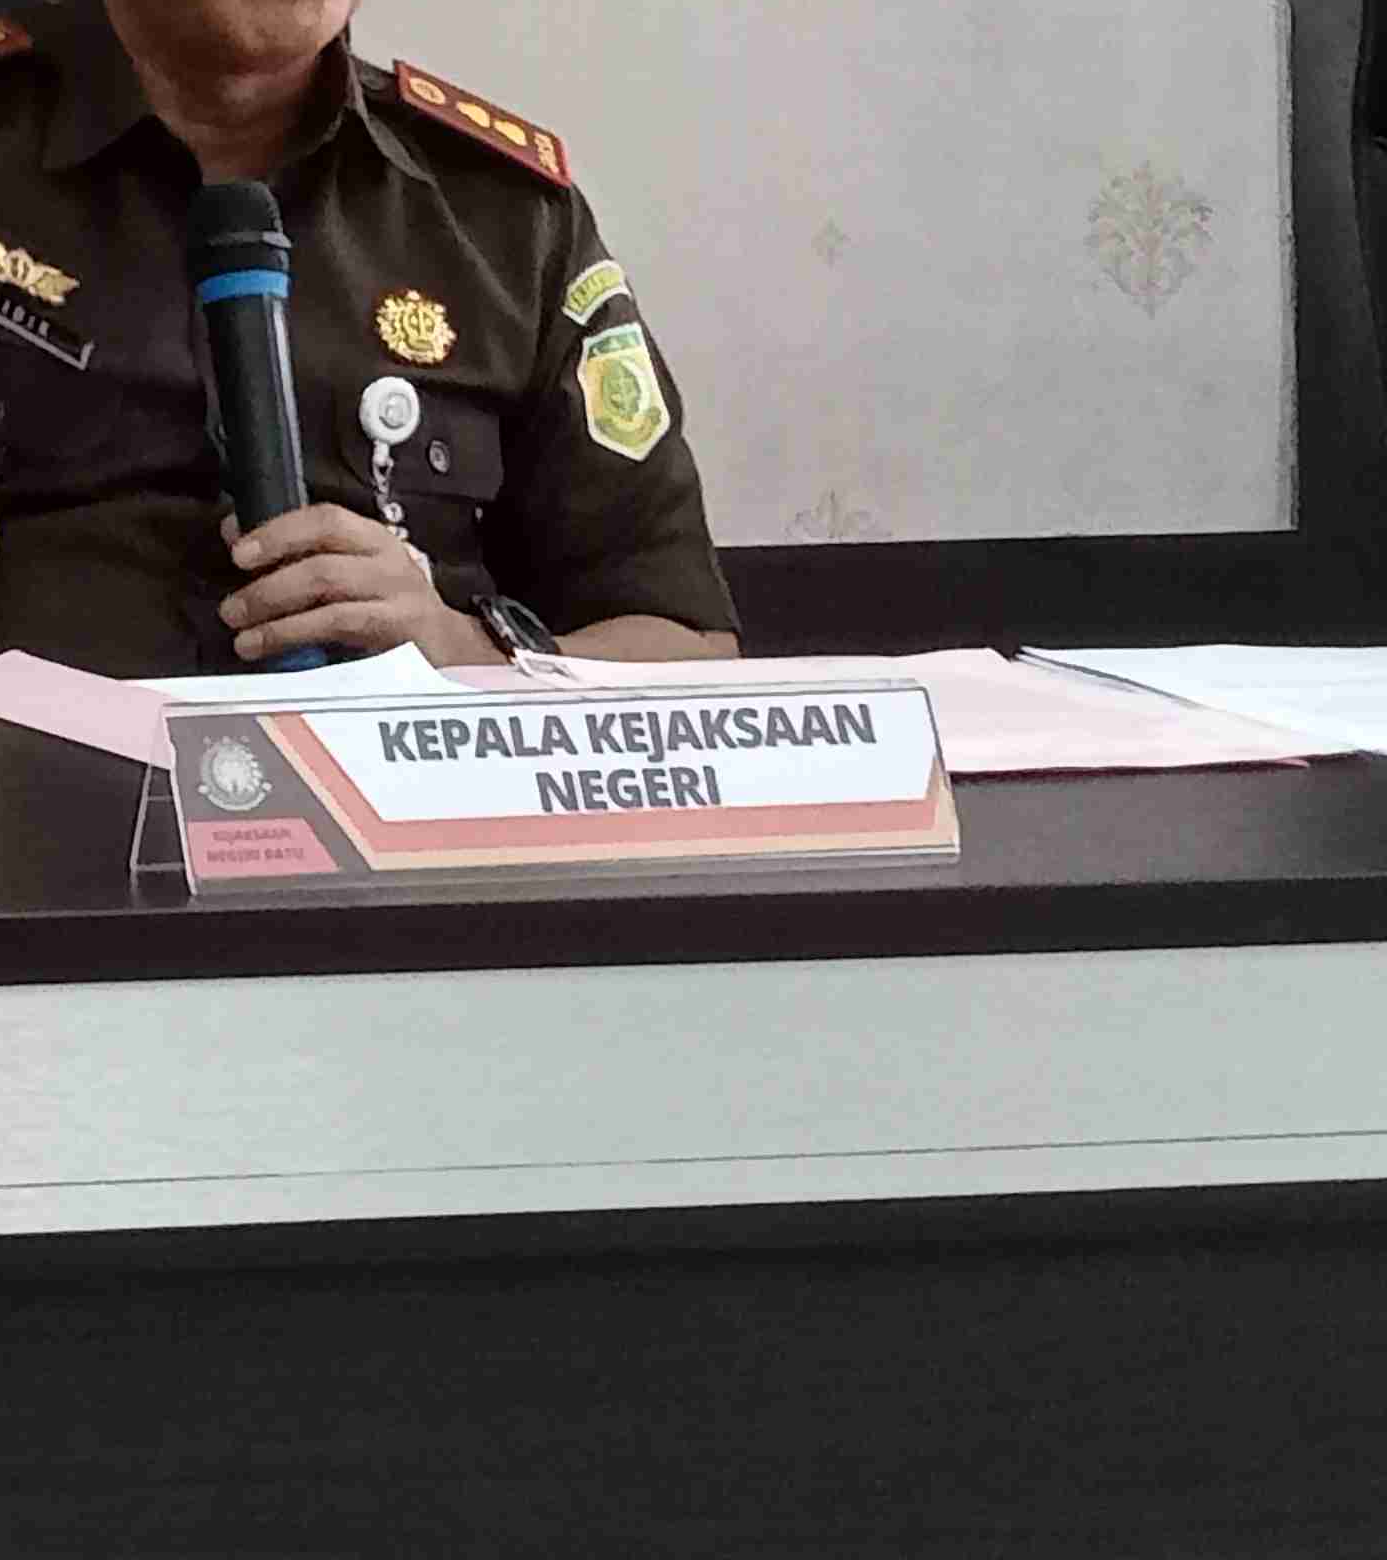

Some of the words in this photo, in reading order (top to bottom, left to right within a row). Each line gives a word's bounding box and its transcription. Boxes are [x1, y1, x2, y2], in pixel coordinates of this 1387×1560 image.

[378, 713, 578, 763] KEPALA
[588, 702, 877, 761] KEJAKSAAN
[535, 765, 723, 814] NEGERI
